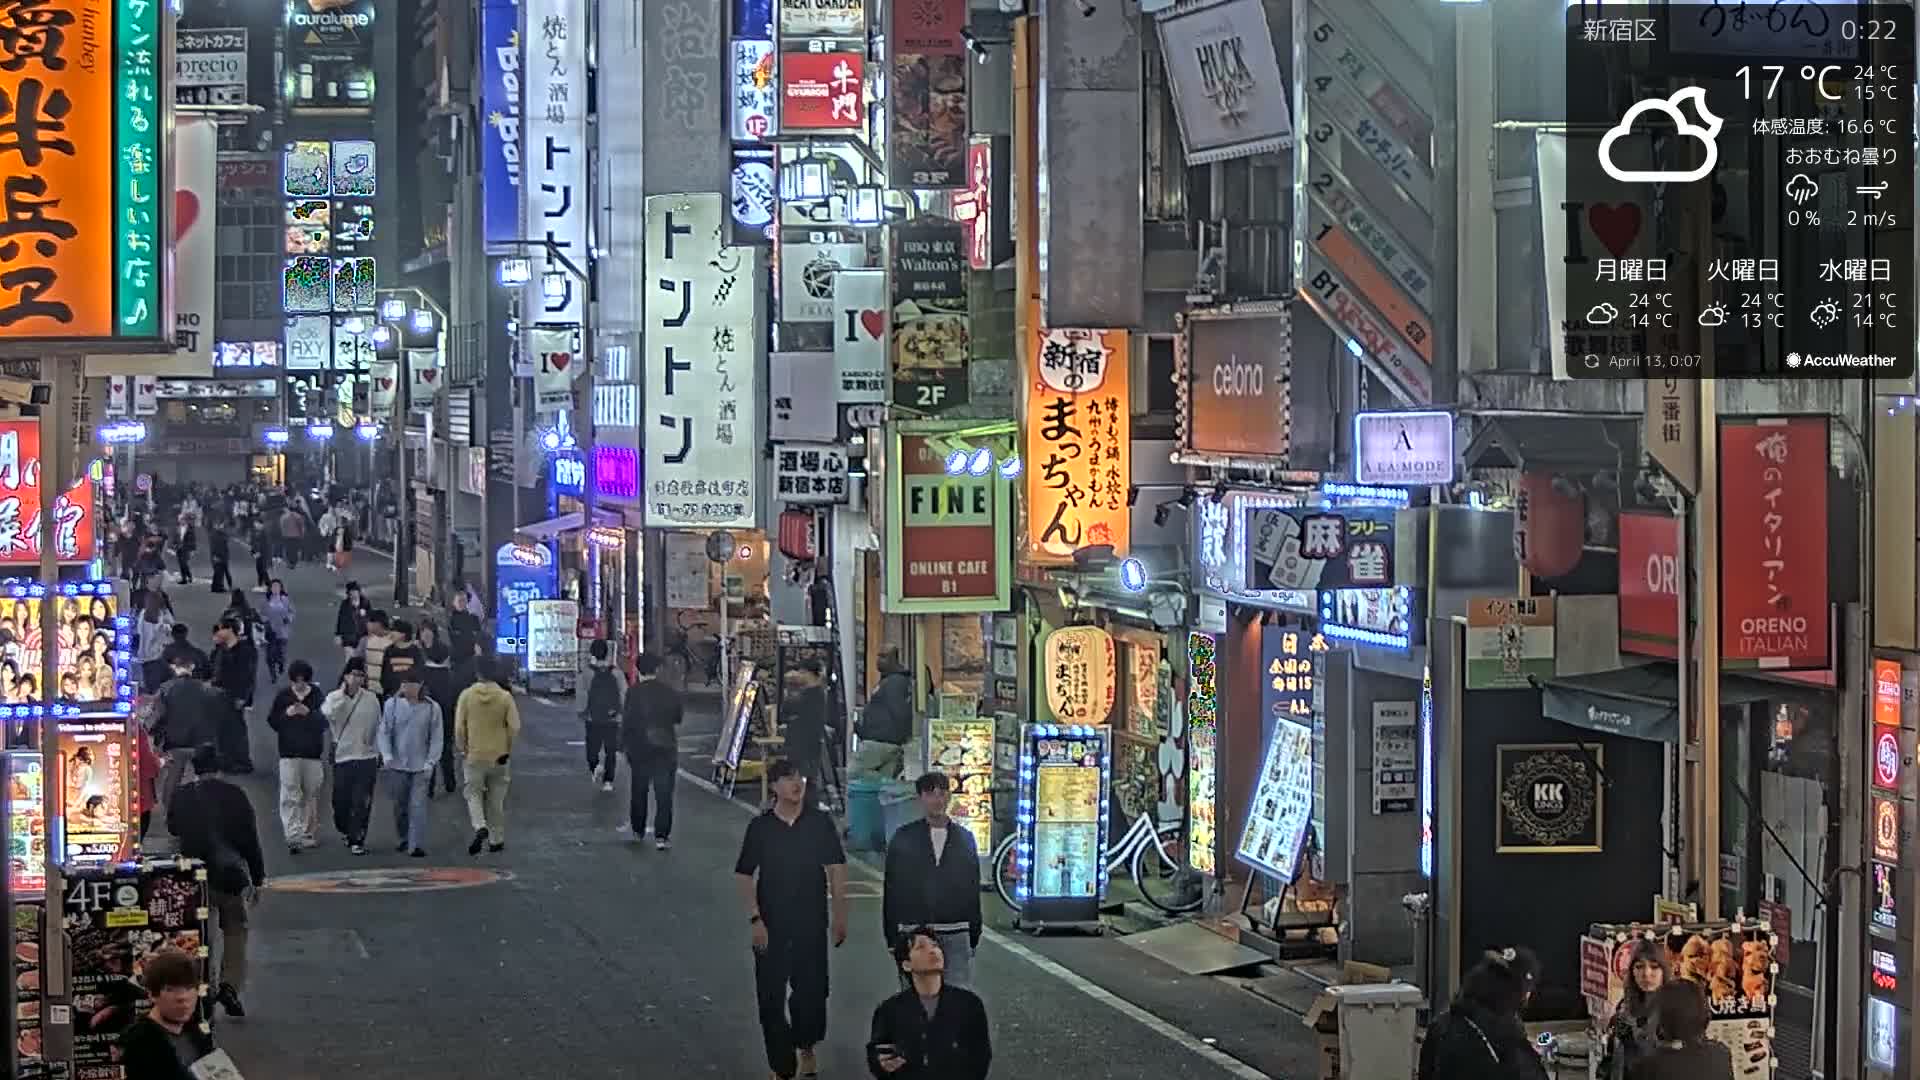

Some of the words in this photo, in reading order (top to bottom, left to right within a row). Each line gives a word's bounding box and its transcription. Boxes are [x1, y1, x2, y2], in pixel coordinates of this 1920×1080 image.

[783, 0, 812, 9] MEAT
[815, 0, 862, 9] GARDEN
[296, 11, 369, 26] auralume
[1314, 23, 1335, 44] 5
[808, 41, 837, 53] 2F
[542, 15, 569, 125] 焼とん酒場
[1195, 36, 1254, 90] HUCK
[830, 59, 859, 122] 牛門
[1313, 75, 1333, 93] 4
[747, 117, 767, 133] 1F
[1314, 123, 1334, 144] 3
[1312, 173, 1335, 195] 2
[541, 136, 572, 312] トントン
[1316, 223, 1334, 242] 1
[900, 257, 958, 272] Walton's
[1311, 268, 1340, 301] B1
[844, 309, 859, 342] I
[292, 340, 325, 354] AXY
[660, 210, 692, 464] トントン
[541, 352, 550, 374] I
[1043, 341, 1103, 375] 新宿
[713, 325, 738, 446] 焼とん酒場
[1063, 374, 1084, 389] の
[1214, 359, 1264, 397] celona
[917, 385, 946, 406] 2F
[779, 451, 844, 472] 酒場心
[1041, 397, 1086, 546] まっちゃん
[1400, 460, 1445, 473] MODE
[779, 476, 844, 494] 新宿本店
[911, 485, 987, 516] FINE
[1348, 521, 1390, 535] フリー
[1754, 432, 1788, 605] 俺のイタリアン
[910, 561, 955, 576] ONLINE
[957, 560, 989, 575] CAFE
[942, 579, 957, 594] B1
[1740, 617, 1807, 634] ORENO
[1739, 634, 1809, 652] ITALIAN
[1055, 663, 1075, 718] まっちゃん
[1534, 783, 1564, 801] KK
[66, 879, 112, 912] 4F
